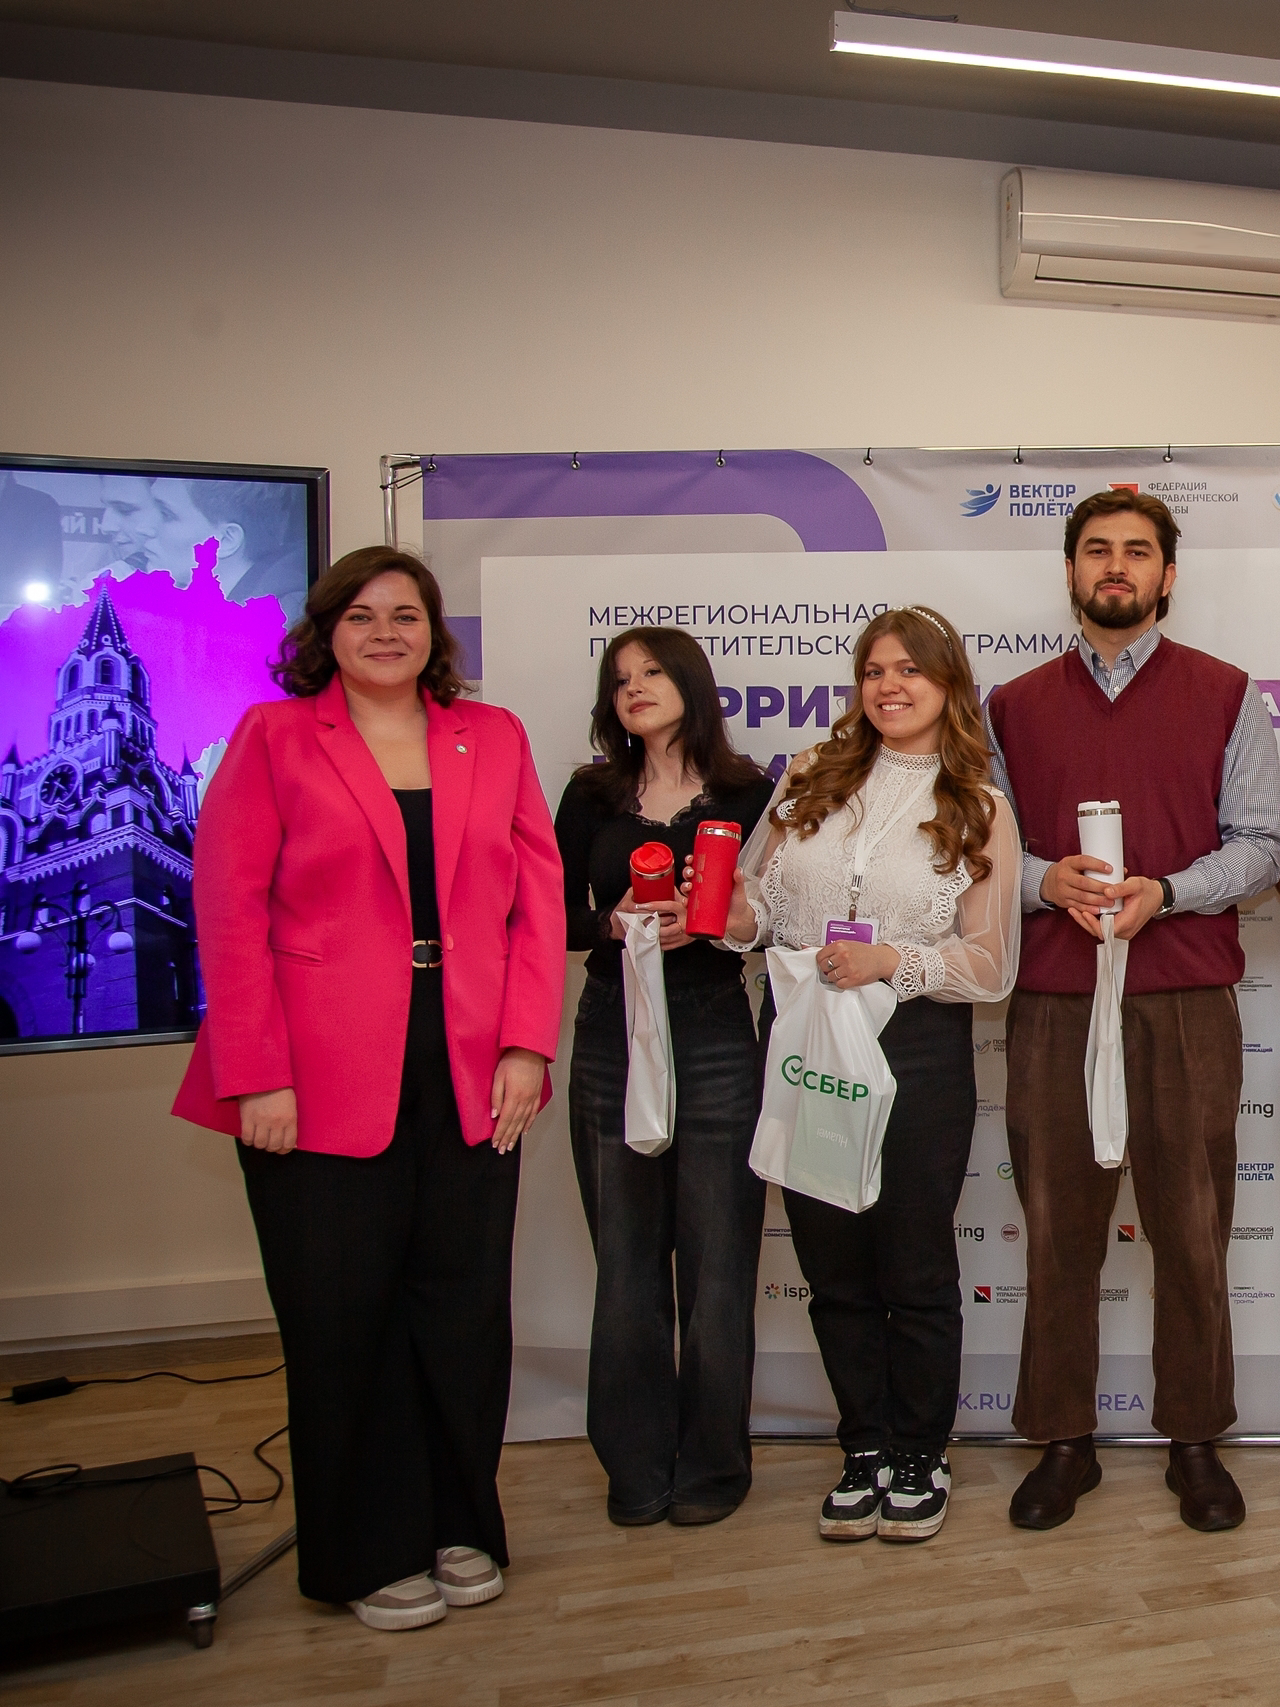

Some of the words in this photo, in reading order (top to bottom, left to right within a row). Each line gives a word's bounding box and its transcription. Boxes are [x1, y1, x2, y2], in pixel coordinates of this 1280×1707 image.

[1009, 484, 1076, 498] ВЕКТОР
[1148, 482, 1207, 491] ФЕДЕРАЦИЯ
[1152, 492, 1239, 503] ПРАВЛЕНЧЕСКОЙ
[1009, 499, 1074, 516] ПОЛЁТА
[589, 603, 888, 626] МЕЖРЕГИОНАЛЬНАЯ
[963, 633, 1079, 653] ГРАММА
[802, 1070, 869, 1102] СБЕР
[1240, 1100, 1274, 1118] ring
[1237, 1163, 1275, 1171] ВЕКТОР
[1237, 1170, 1275, 1181] ПОЛЁТА
[954, 1223, 985, 1242] ring
[1098, 1394, 1145, 1411] REA
